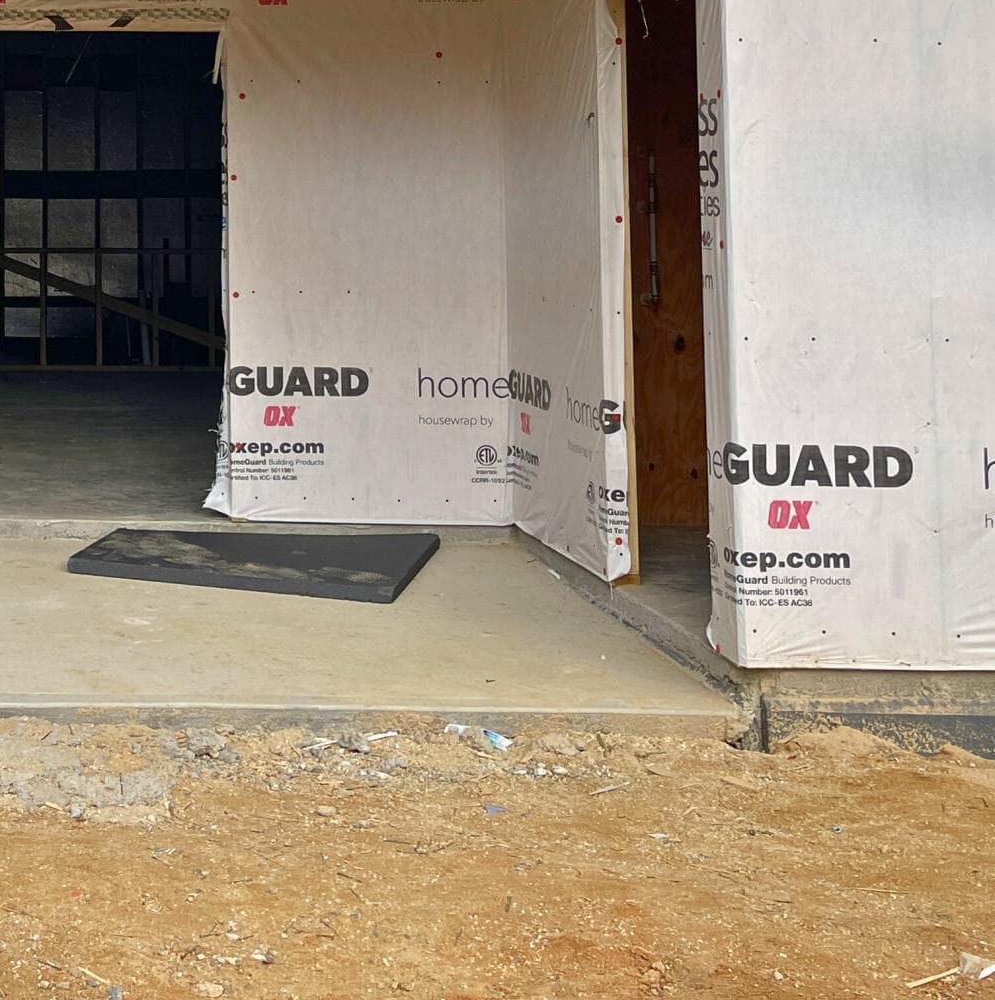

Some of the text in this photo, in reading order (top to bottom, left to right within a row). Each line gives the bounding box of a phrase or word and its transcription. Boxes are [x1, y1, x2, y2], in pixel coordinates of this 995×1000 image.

[417, 367, 552, 411] homeGUARD
[263, 405, 296, 427] OX
[418, 414, 494, 428] housewrap by
[566, 386, 627, 434] homeG
[768, 500, 813, 530] OX
[723, 546, 851, 572] oxep.com
[738, 587, 773, 596] Number:
[774, 588, 809, 596] 5011961
[771, 575, 851, 587] Building Products
[745, 598, 813, 607] To: ICC-ES AC38
